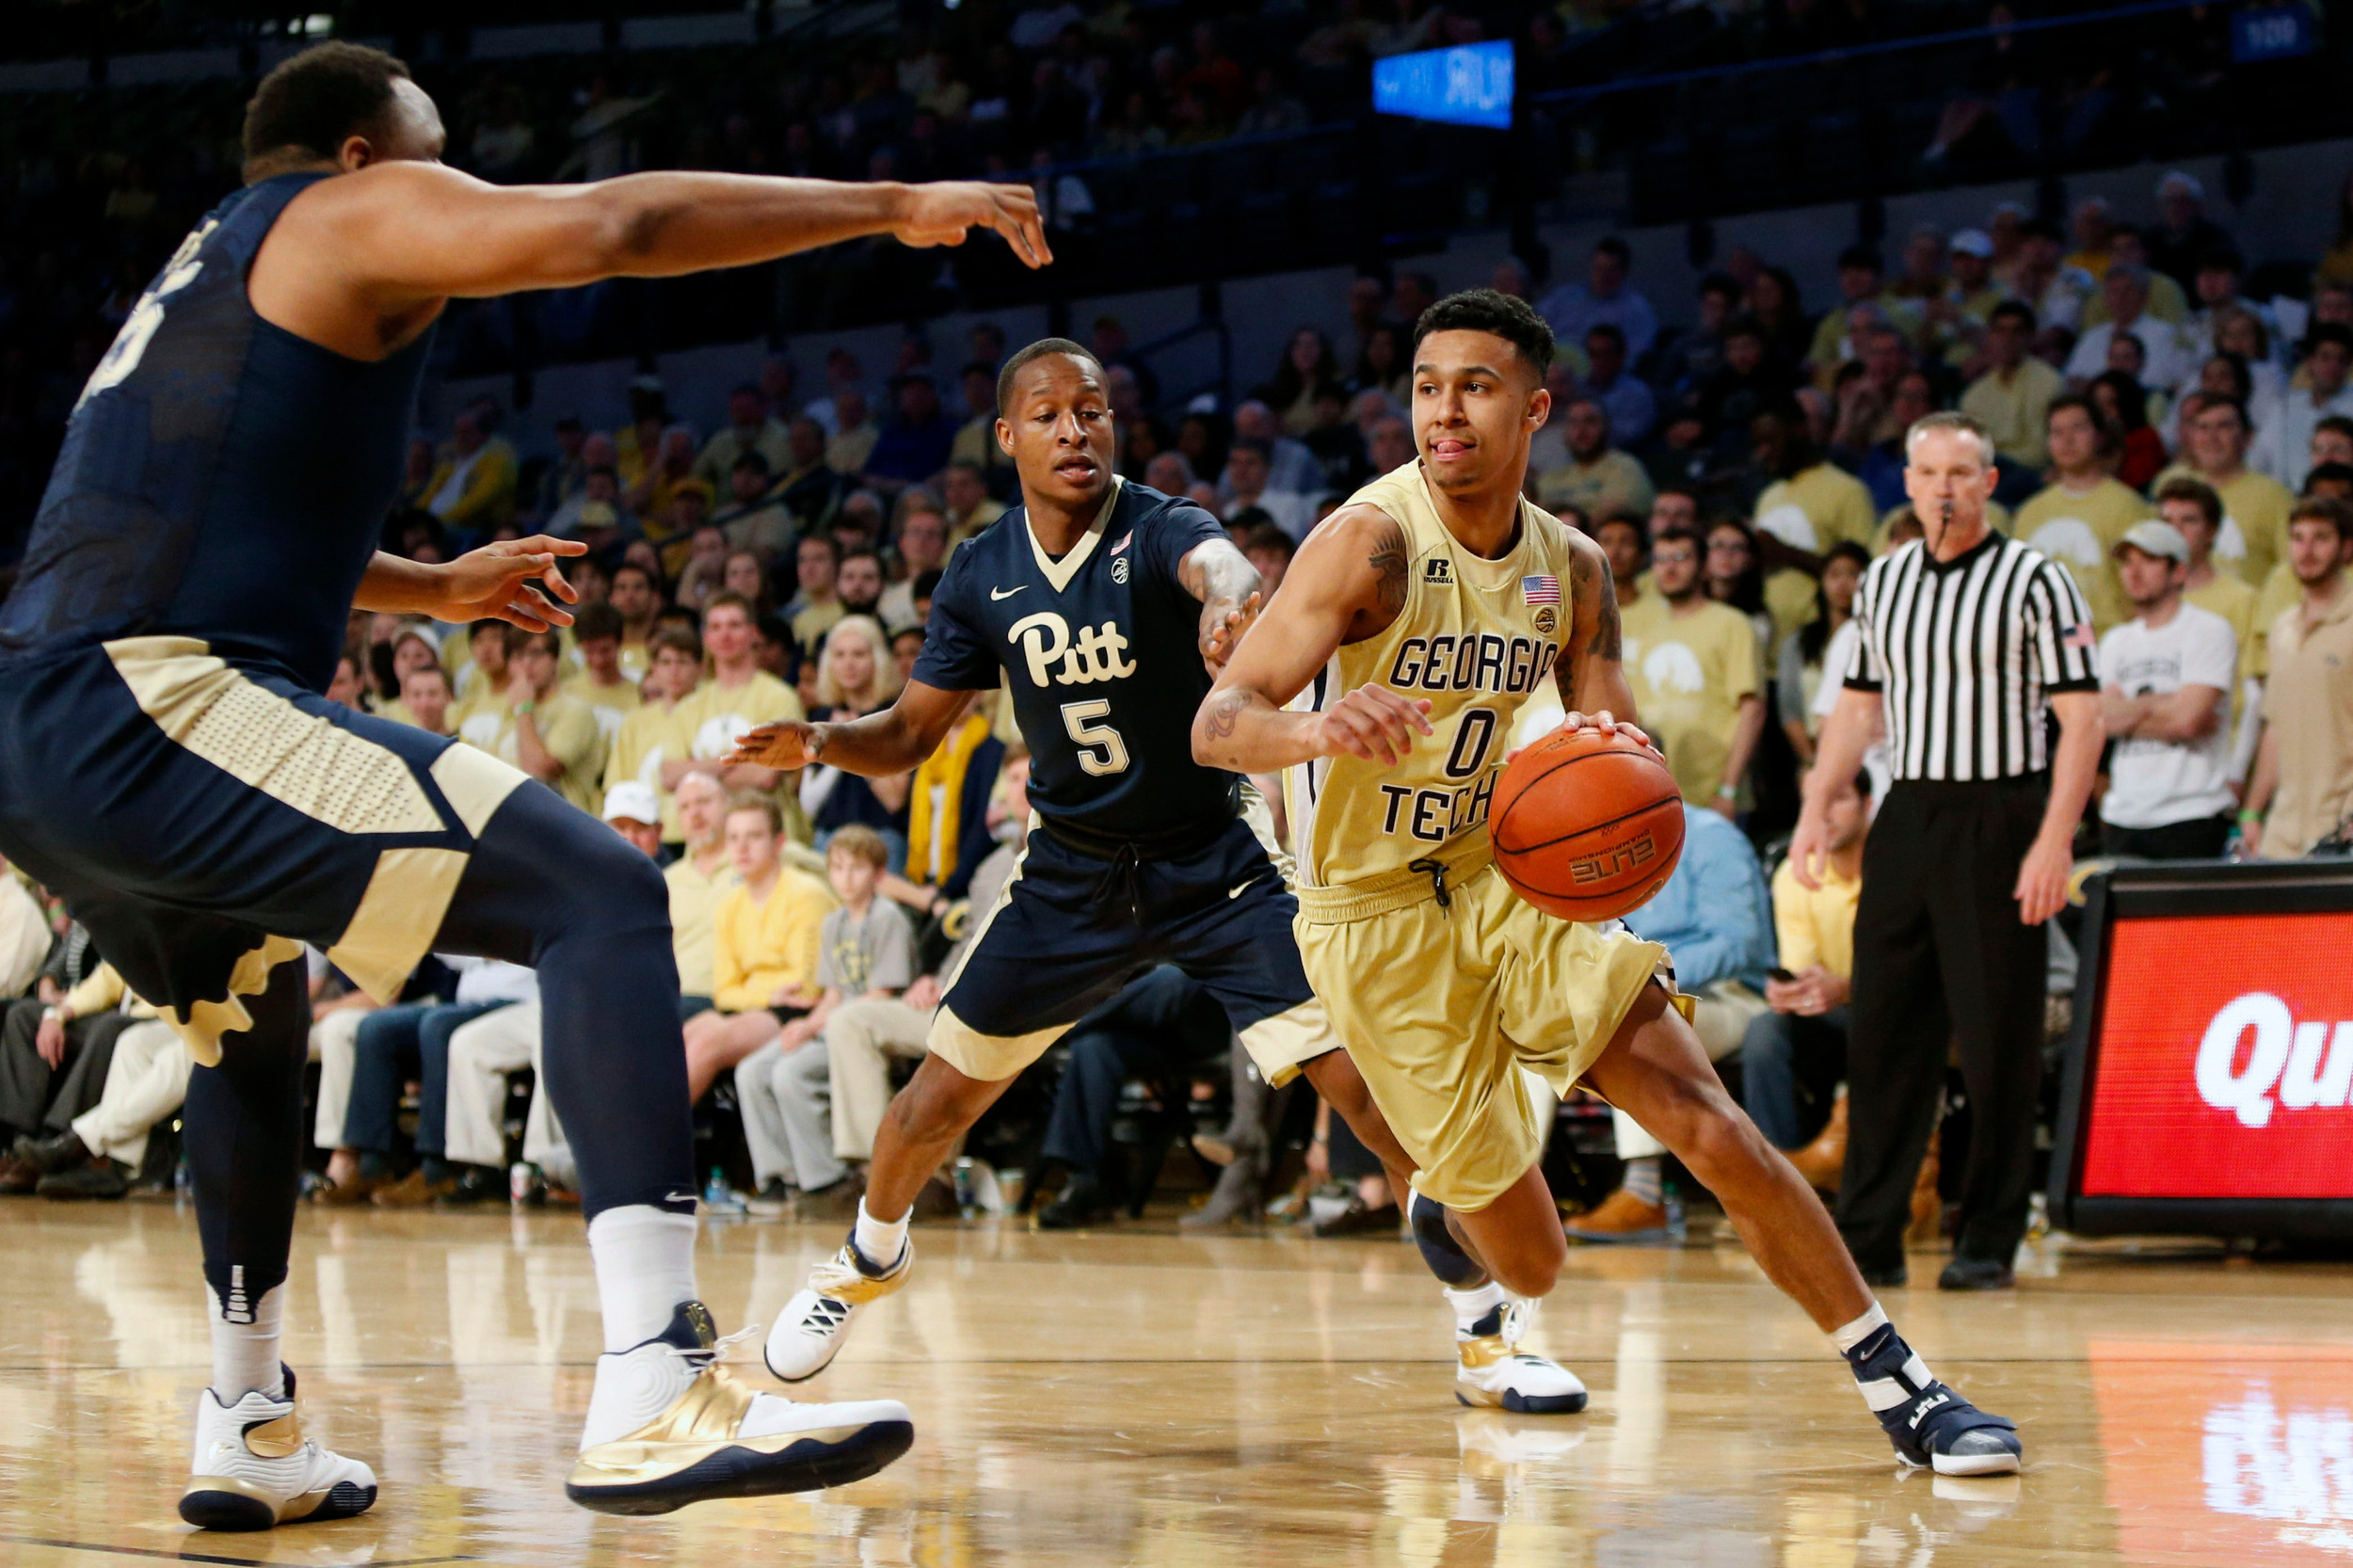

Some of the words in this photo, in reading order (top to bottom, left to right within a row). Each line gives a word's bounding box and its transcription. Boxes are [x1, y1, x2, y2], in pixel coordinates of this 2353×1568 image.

[1423, 576, 1454, 584] RUSSELL
[1008, 612, 1137, 688] Pitt
[1060, 698, 1129, 776] 5
[1443, 706, 1498, 780] 0
[1380, 768, 1499, 843] TECH
[1569, 835, 1657, 885] ELITE
[2194, 991, 2353, 1128] Qu
